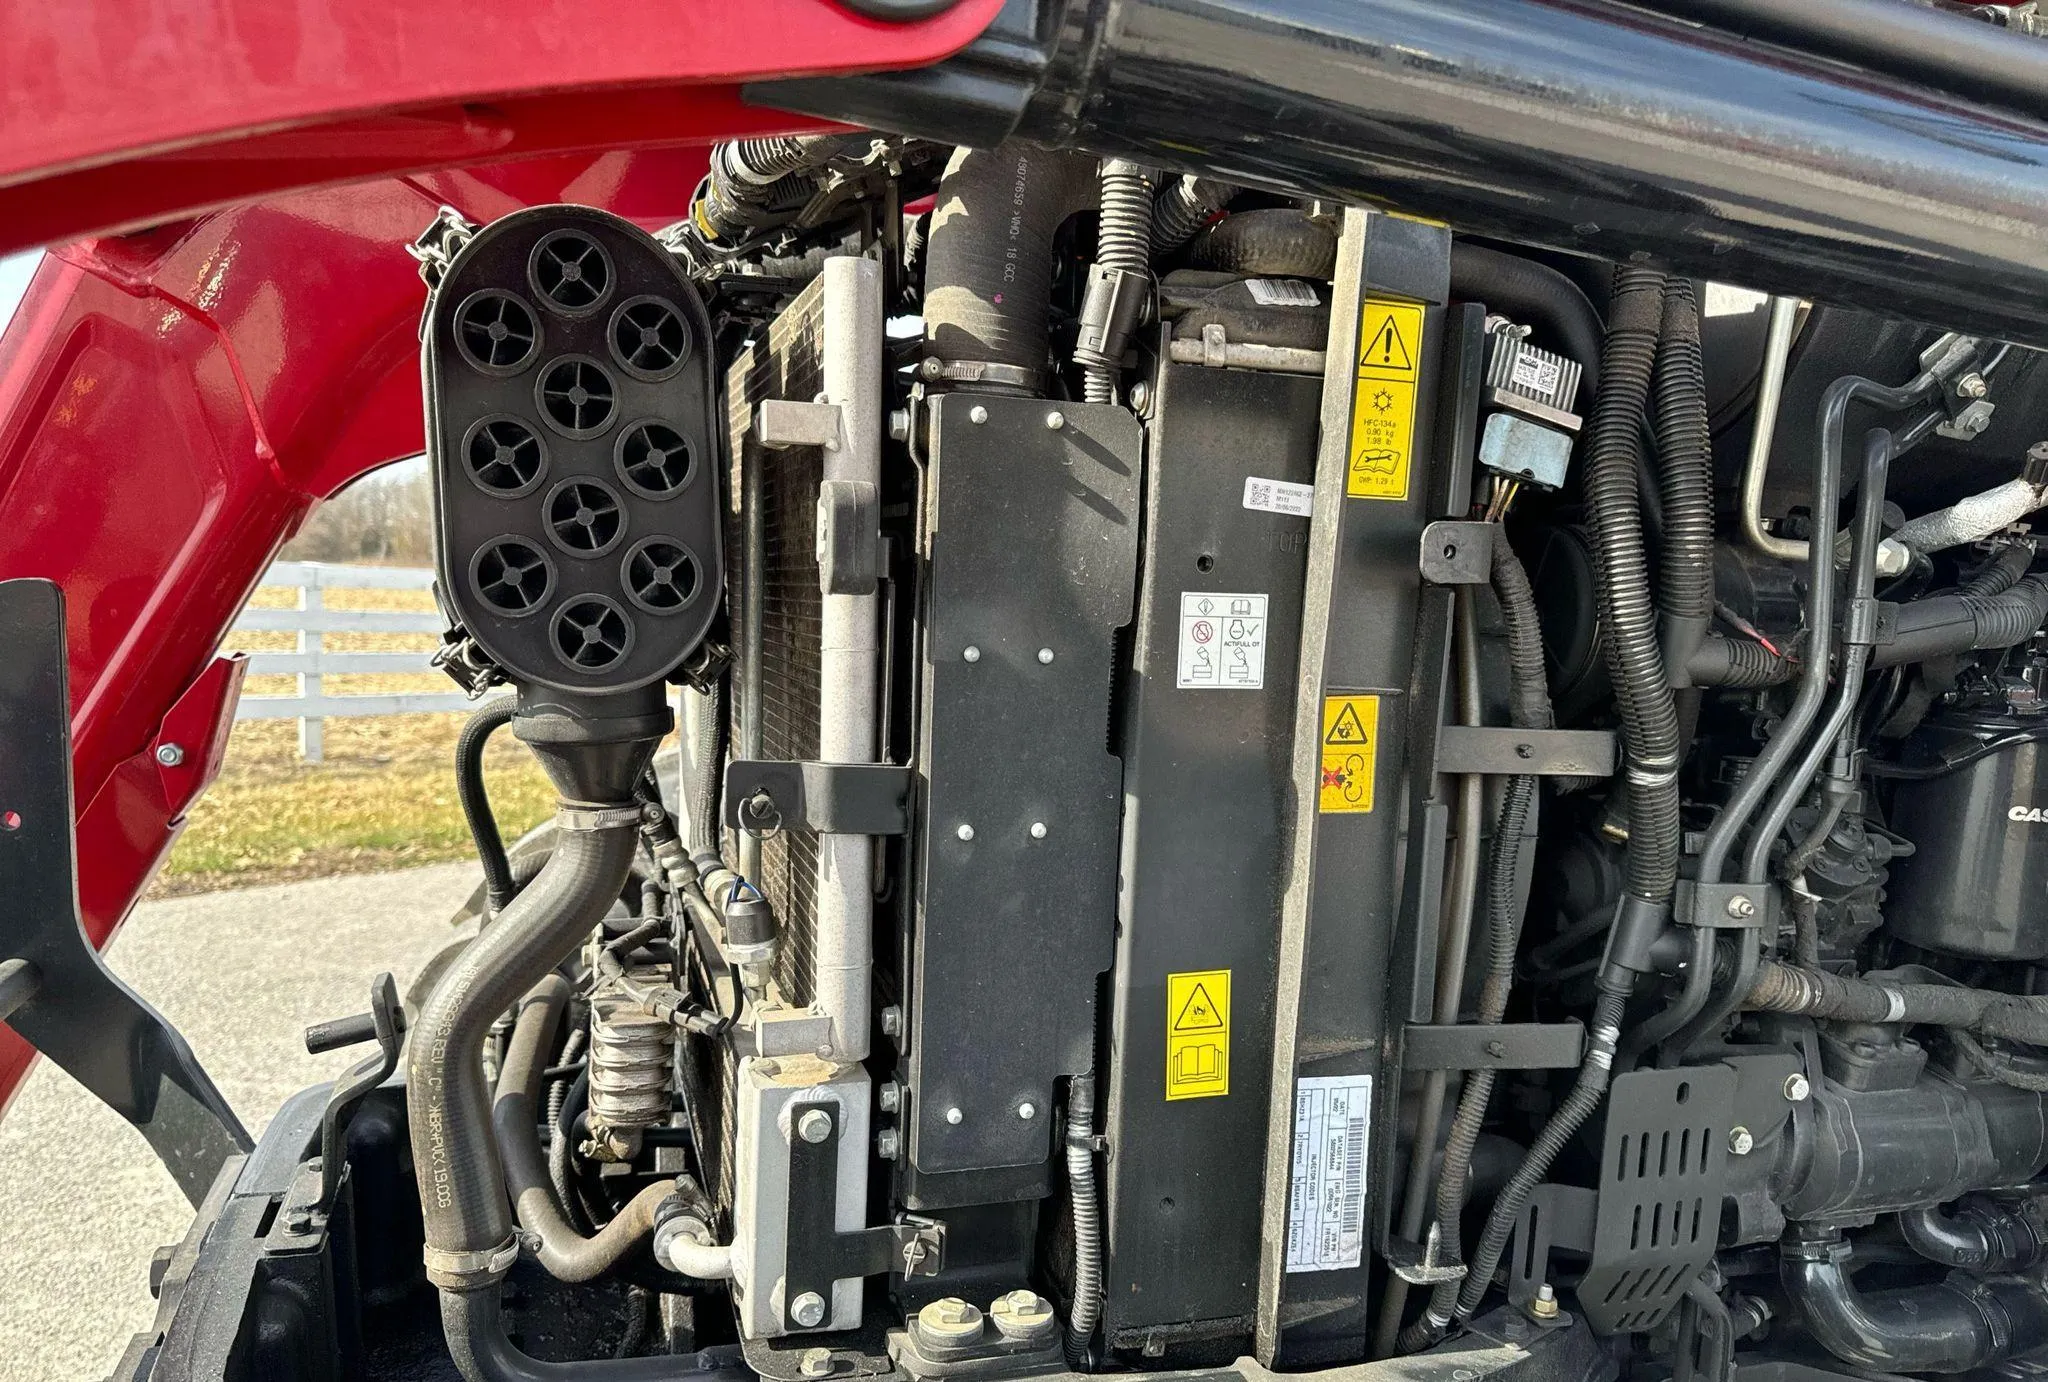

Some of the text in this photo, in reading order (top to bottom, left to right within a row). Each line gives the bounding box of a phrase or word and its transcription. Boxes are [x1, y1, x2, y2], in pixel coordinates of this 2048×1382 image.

[1014, 157, 1028, 206] 48074659
[1006, 247, 1017, 259] 18
[1003, 263, 1016, 283] GCC
[1363, 418, 1397, 428] HFC-134a
[1366, 428, 1394, 438] 0.90 kg
[1367, 437, 1382, 445] 1.98
[1264, 530, 1308, 554] TOP
[1338, 1101, 1346, 1116] DATE
[1336, 1135, 1344, 1160] DATASET
[1308, 1153, 1318, 1201] INJECTOR CODES
